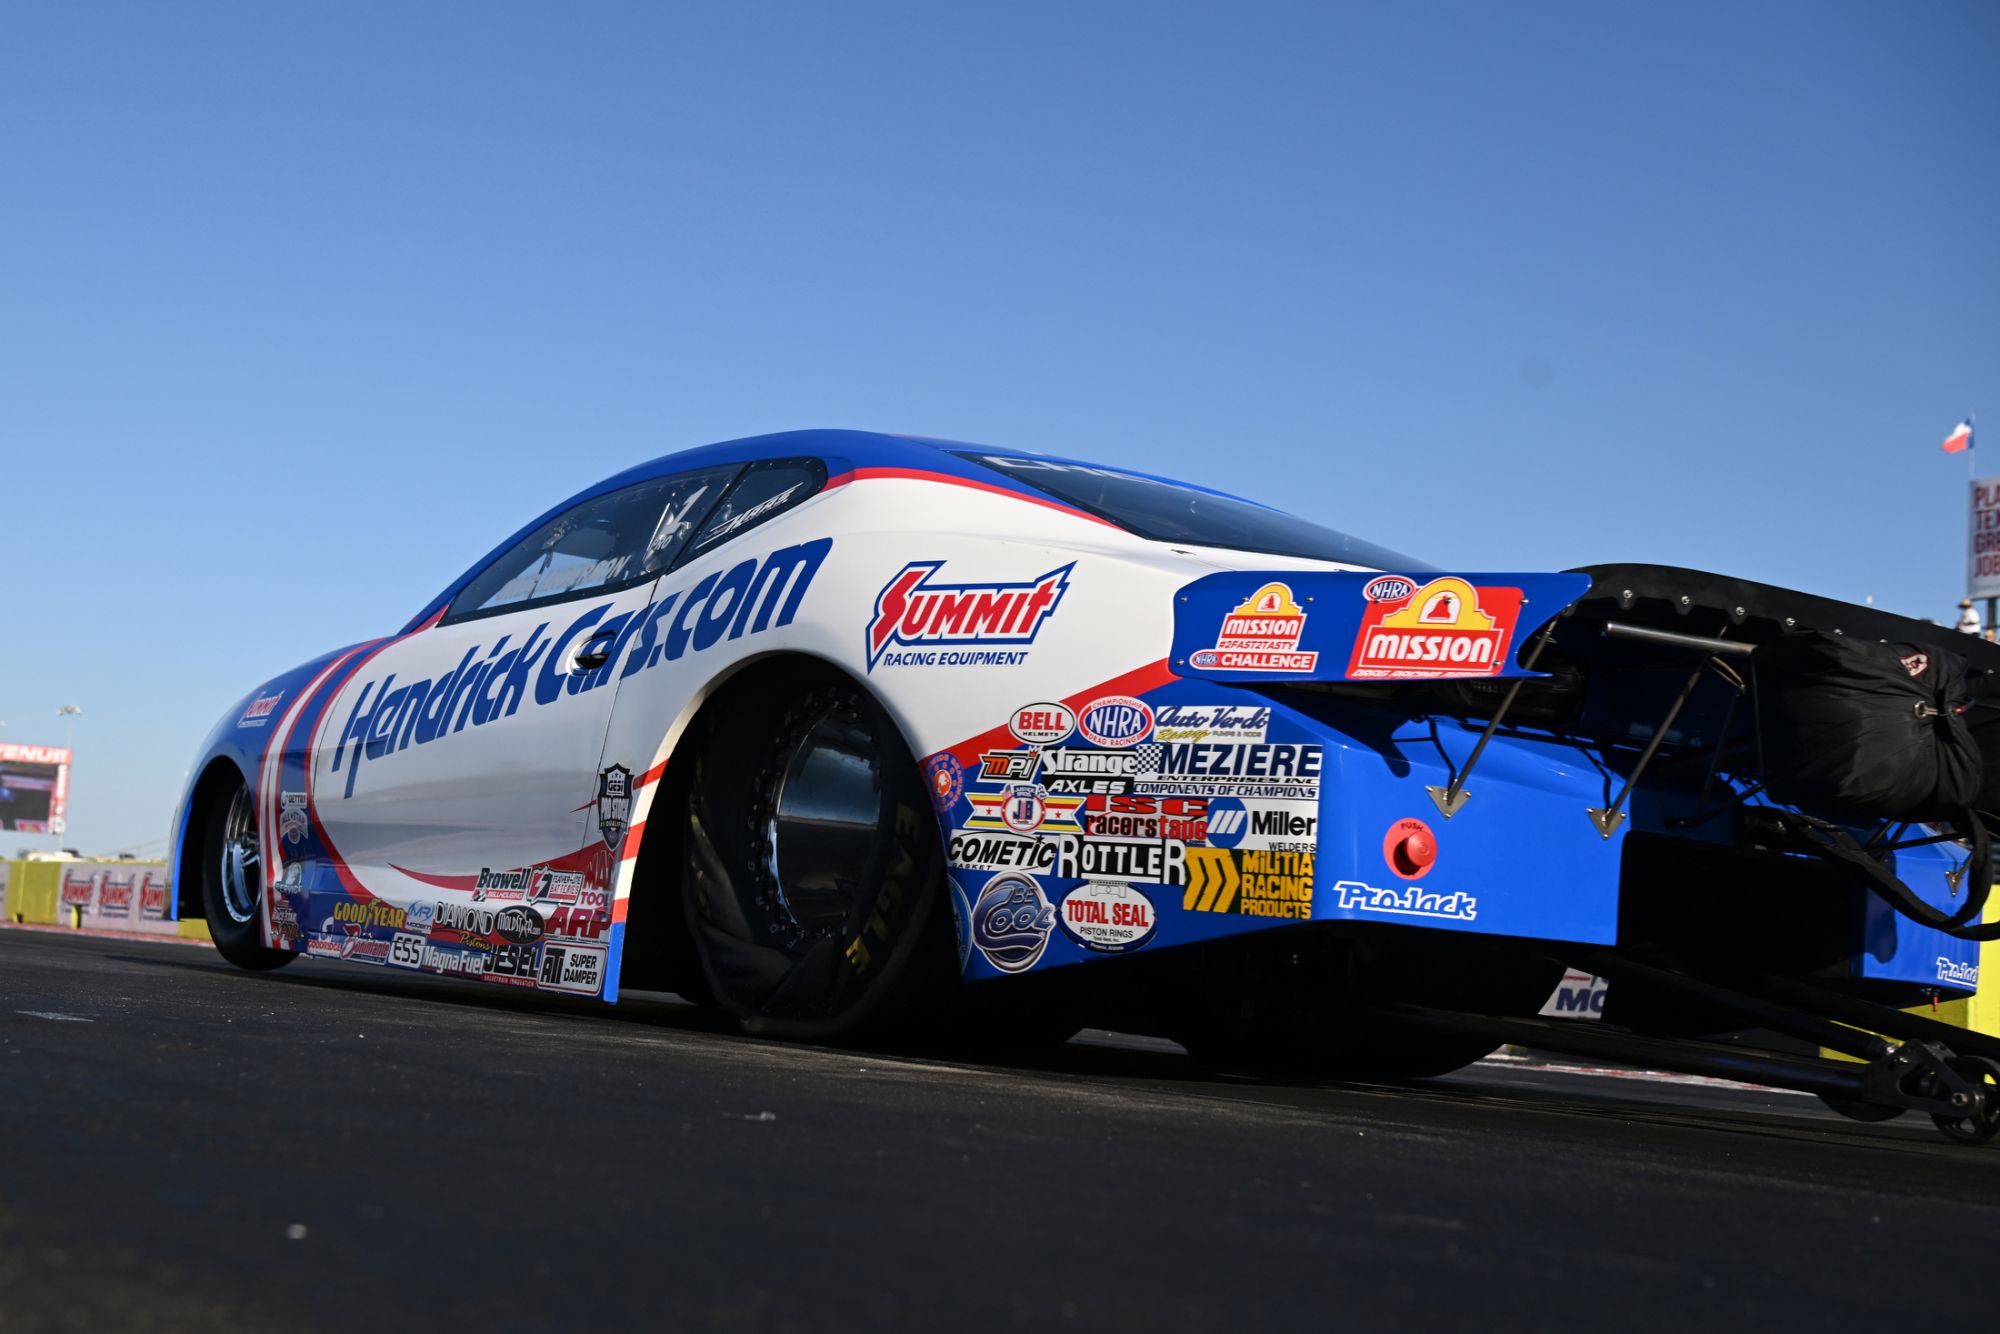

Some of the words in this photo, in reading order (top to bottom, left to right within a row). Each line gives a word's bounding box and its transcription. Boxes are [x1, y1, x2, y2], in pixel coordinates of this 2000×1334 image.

[1371, 581, 1409, 599] NHRA
[871, 568, 1060, 655] SUMMIT
[1225, 619, 1299, 636] MISSION
[1218, 640, 1295, 650] #2FAST2TASTY
[1367, 634, 1492, 663] MISSION
[331, 537, 833, 799] HendrickCars.com
[883, 652, 936, 667] RACING
[938, 651, 1029, 666] EQUIPMENT
[1195, 654, 1217, 665] NHRA
[1221, 653, 1312, 668] CHALLENGE
[1018, 711, 1066, 730] BELL
[1089, 706, 1141, 737] NHRA
[1155, 705, 1210, 728] Auto
[1209, 705, 1270, 730] Verdi
[1088, 732, 1107, 745] DRAG
[1110, 736, 1137, 746] RACING
[982, 754, 1035, 776] MPI
[1041, 746, 1137, 778] Strange
[1158, 744, 1322, 777] MEZIERE
[1048, 780, 1127, 794] AXLES
[1133, 783, 1217, 795] COMPONENTS
[1218, 785, 1235, 796] OF
[1236, 786, 1317, 798] CHAMPIONS
[1157, 775, 1280, 784] ENTERPRISES
[1281, 776, 1319, 785] INC
[1085, 795, 1209, 817] ISC
[1251, 810, 1317, 836] Miller
[950, 836, 1057, 868] COMETIC
[1268, 842, 1317, 852] WELDERS
[951, 862, 993, 870] GASKET
[1057, 834, 1186, 885] ROTTLER
[1242, 849, 1315, 876] MILITIA
[477, 867, 532, 890] Browell
[550, 884, 580, 895] BATTERIES
[1241, 873, 1313, 901] RACING
[1241, 898, 1312, 919] PRODUCTS
[1333, 880, 1477, 920] Pro-Jack
[434, 901, 494, 936] DIAMOND
[544, 906, 610, 939] ARP
[1066, 899, 1109, 925] TOTAL
[1112, 902, 1149, 927] SEAL
[1079, 926, 1107, 936] PISTON
[1109, 928, 1134, 938] RINGS
[393, 935, 421, 964] ESS
[423, 945, 483, 974] MagnaFuel
[483, 944, 540, 978] JESEL
[570, 953, 598, 969] SUPER
[564, 968, 598, 985] DAMPER
